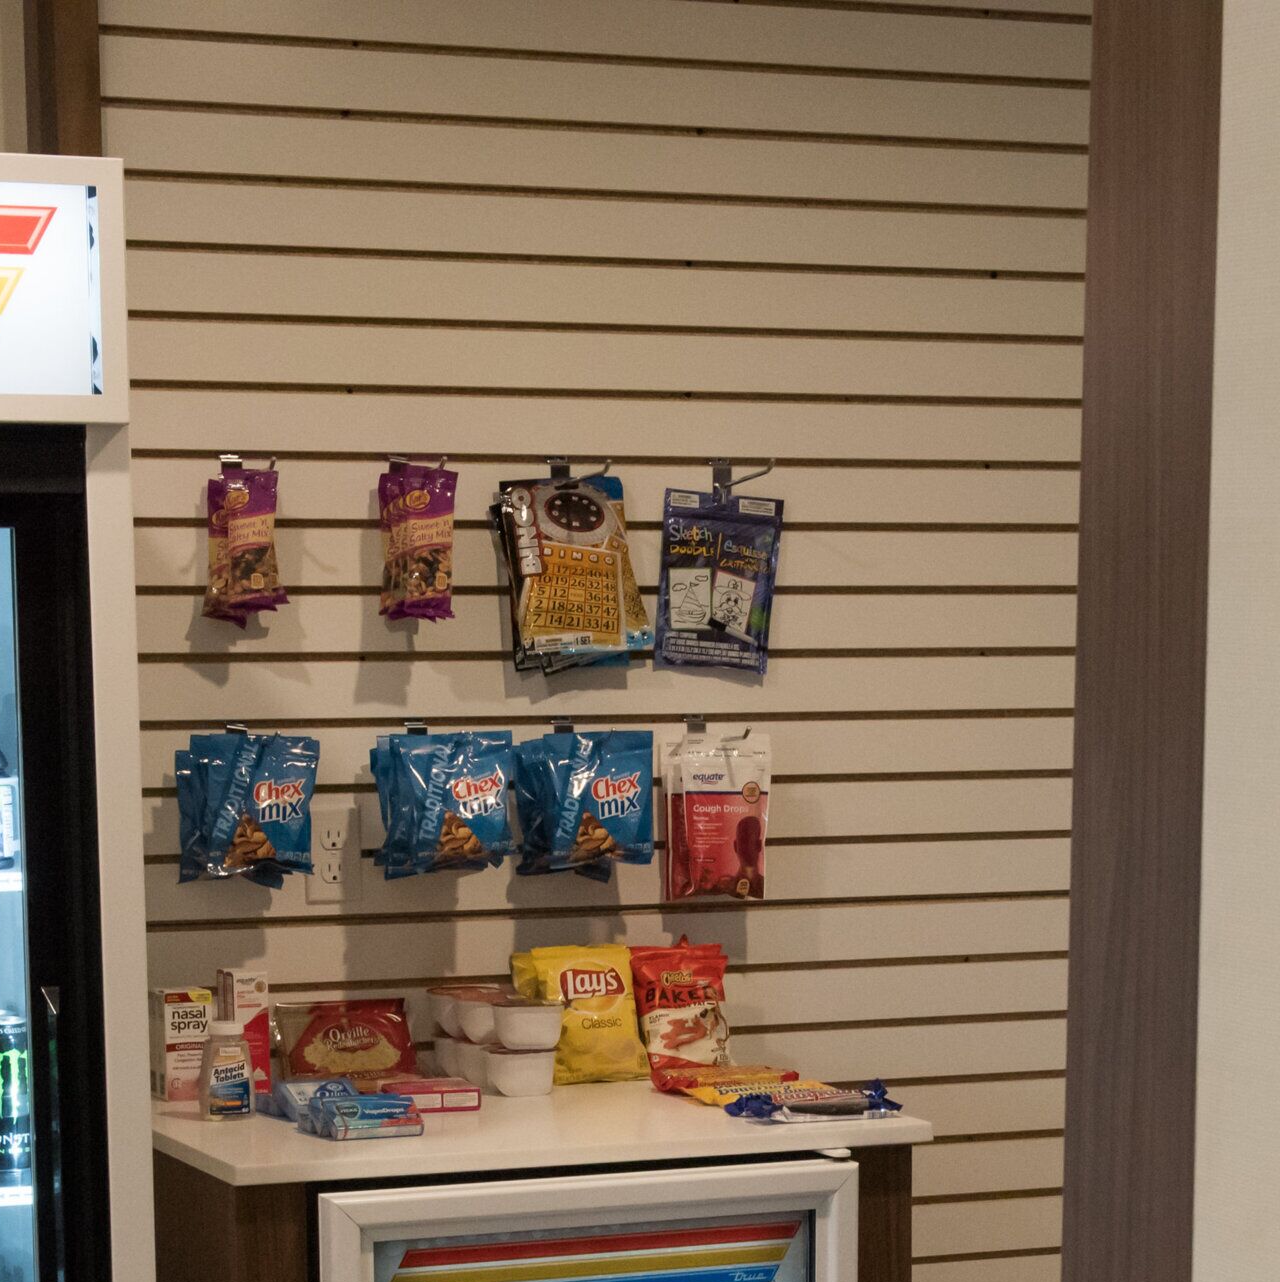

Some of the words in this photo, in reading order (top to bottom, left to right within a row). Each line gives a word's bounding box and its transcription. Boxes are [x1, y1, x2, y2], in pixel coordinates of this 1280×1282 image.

[668, 524, 713, 542] Sketch
[543, 547, 614, 565] BINGO
[556, 564, 568, 574] 17
[572, 566, 585, 576] 22
[555, 575, 568, 585] 19
[570, 578, 585, 588] 26
[586, 581, 601, 590] 32
[603, 582, 616, 592] 48
[537, 587, 545, 596] 5
[553, 587, 567, 598] 12
[587, 592, 601, 601] 36
[603, 594, 617, 604] 44
[534, 600, 543, 610] 2
[551, 601, 565, 611] 18
[568, 603, 583, 613] 28
[585, 605, 601, 614] 37
[603, 608, 617, 617] 47
[532, 614, 541, 624] 7
[549, 615, 563, 625] 14
[566, 617, 581, 627] 21
[583, 620, 599, 630] 33
[603, 621, 616, 631] 41
[580, 636, 591, 645] SET
[452, 771, 503, 800] Chex
[591, 771, 642, 801] Chex
[692, 773, 725, 784] equate
[212, 743, 259, 840] TRADITIONAL
[254, 778, 307, 803] Chex
[260, 797, 303, 823] mix
[599, 791, 641, 820] mix
[693, 804, 721, 814] Cough
[171, 1005, 206, 1020] nasal
[170, 1020, 208, 1033] spray
[581, 1016, 622, 1030] Classic
[328, 1026, 370, 1042] Orville
[213, 1063, 245, 1076] Antacid
[214, 1072, 244, 1083] Tablets
